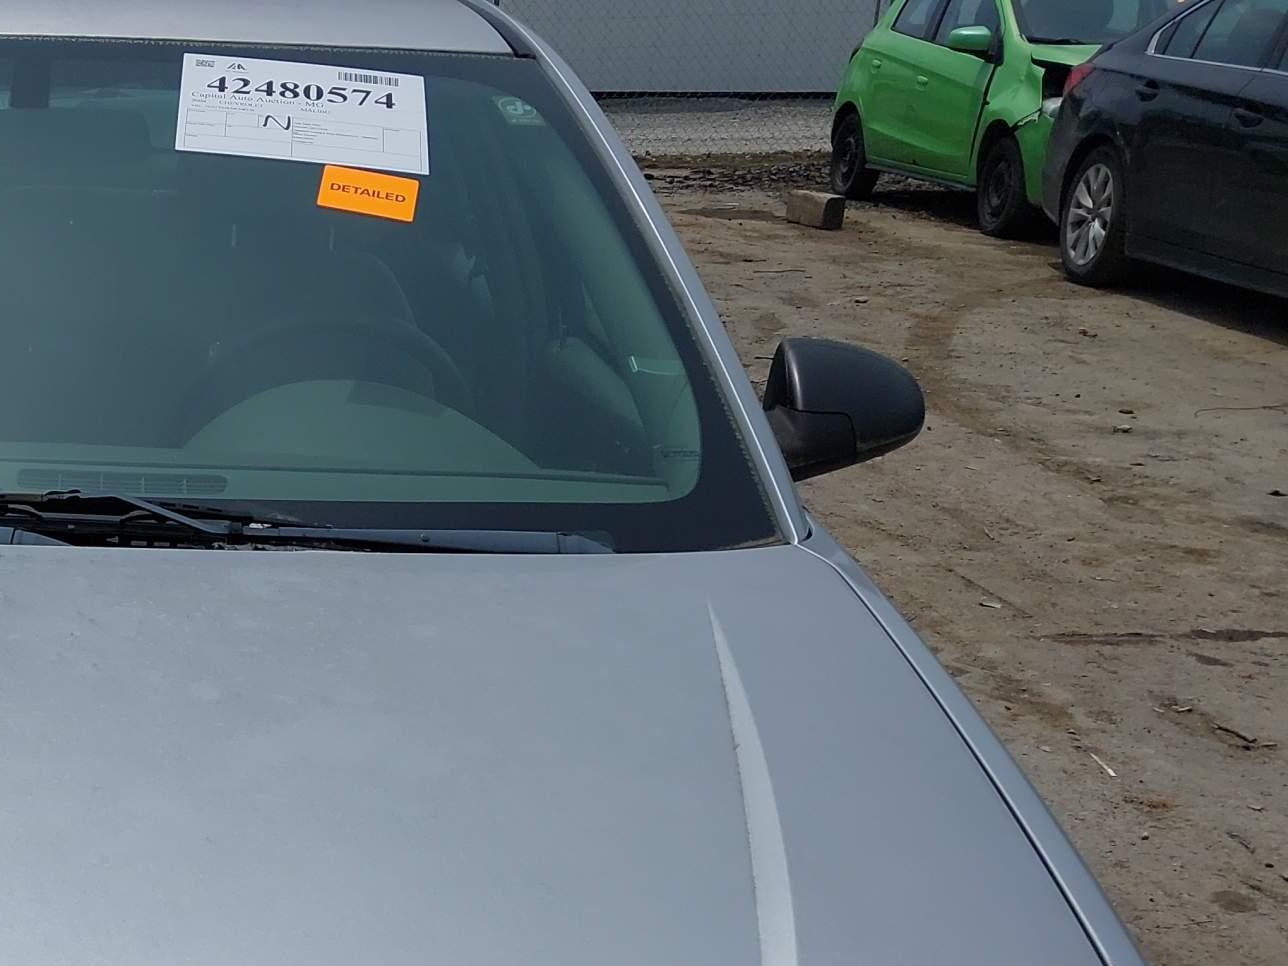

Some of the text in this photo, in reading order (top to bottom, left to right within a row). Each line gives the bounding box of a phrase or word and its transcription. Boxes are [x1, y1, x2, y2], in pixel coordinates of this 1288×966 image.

[191, 91, 226, 101] Capital
[256, 97, 296, 106] Auction
[206, 75, 396, 110] 42480574
[262, 114, 292, 131] N
[329, 182, 406, 203] DETAILED
